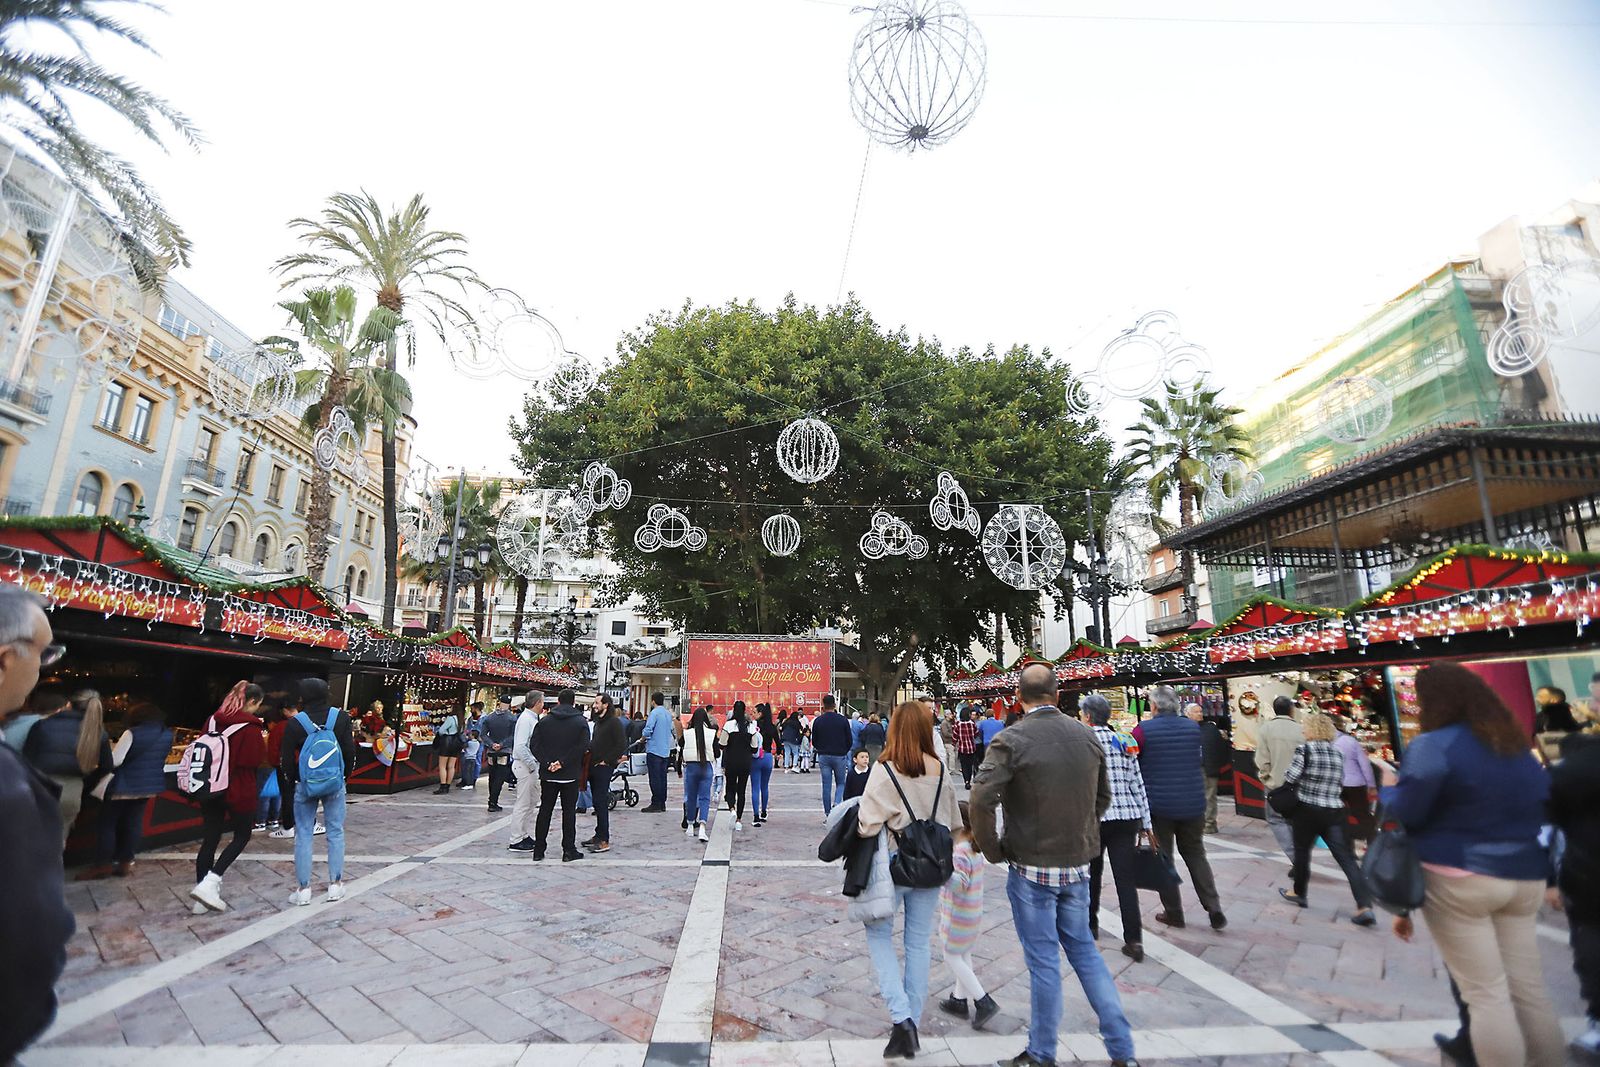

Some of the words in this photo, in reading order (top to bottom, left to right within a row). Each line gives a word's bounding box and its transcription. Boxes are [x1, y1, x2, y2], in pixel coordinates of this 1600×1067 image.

[742, 666, 763, 688] La
[761, 669, 778, 686] luz
[778, 669, 795, 682] del
[795, 667, 821, 683] Sur
[746, 662, 779, 670] NAVIDAD
[188, 747, 206, 792] FILA
